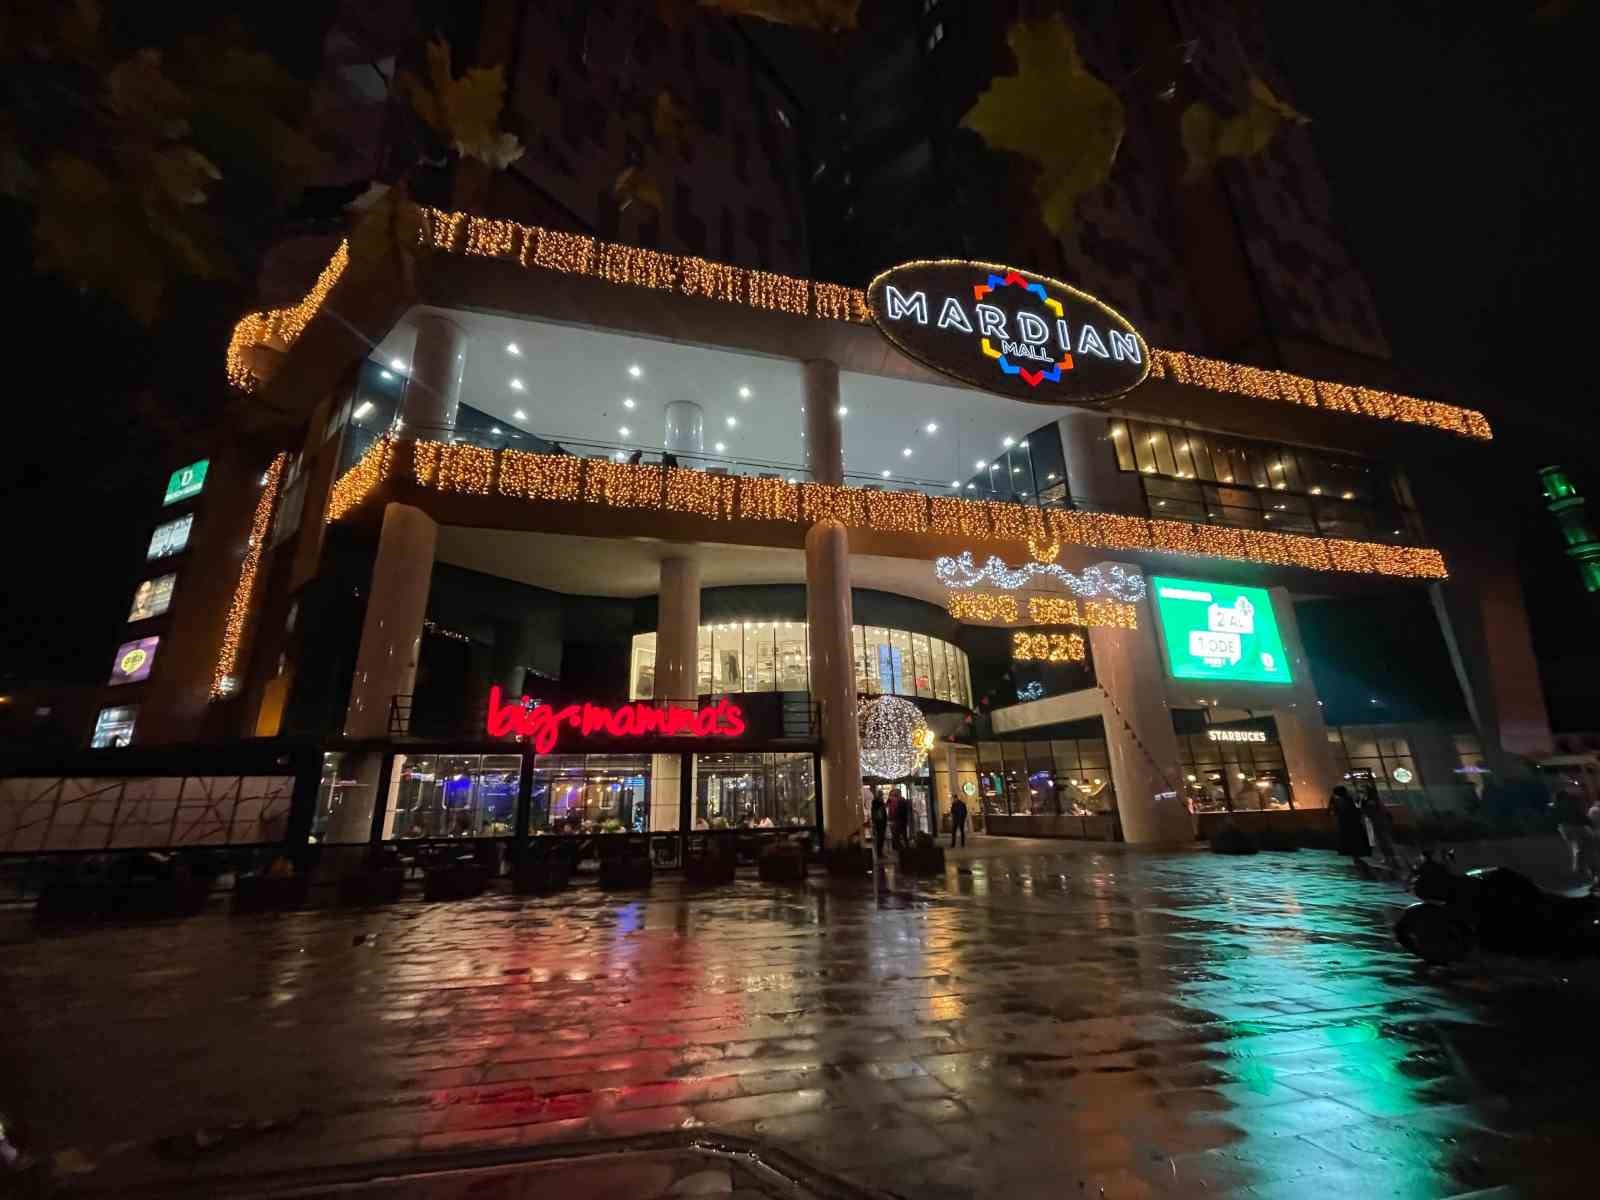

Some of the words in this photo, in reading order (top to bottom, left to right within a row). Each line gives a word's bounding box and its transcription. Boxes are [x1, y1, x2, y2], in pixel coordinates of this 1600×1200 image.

[886, 285, 1141, 364] MARDIAN
[1001, 339, 1055, 362] MALL
[487, 684, 580, 754] big
[580, 697, 746, 737] mamma's
[1208, 730, 1266, 742] STARBUCKS
